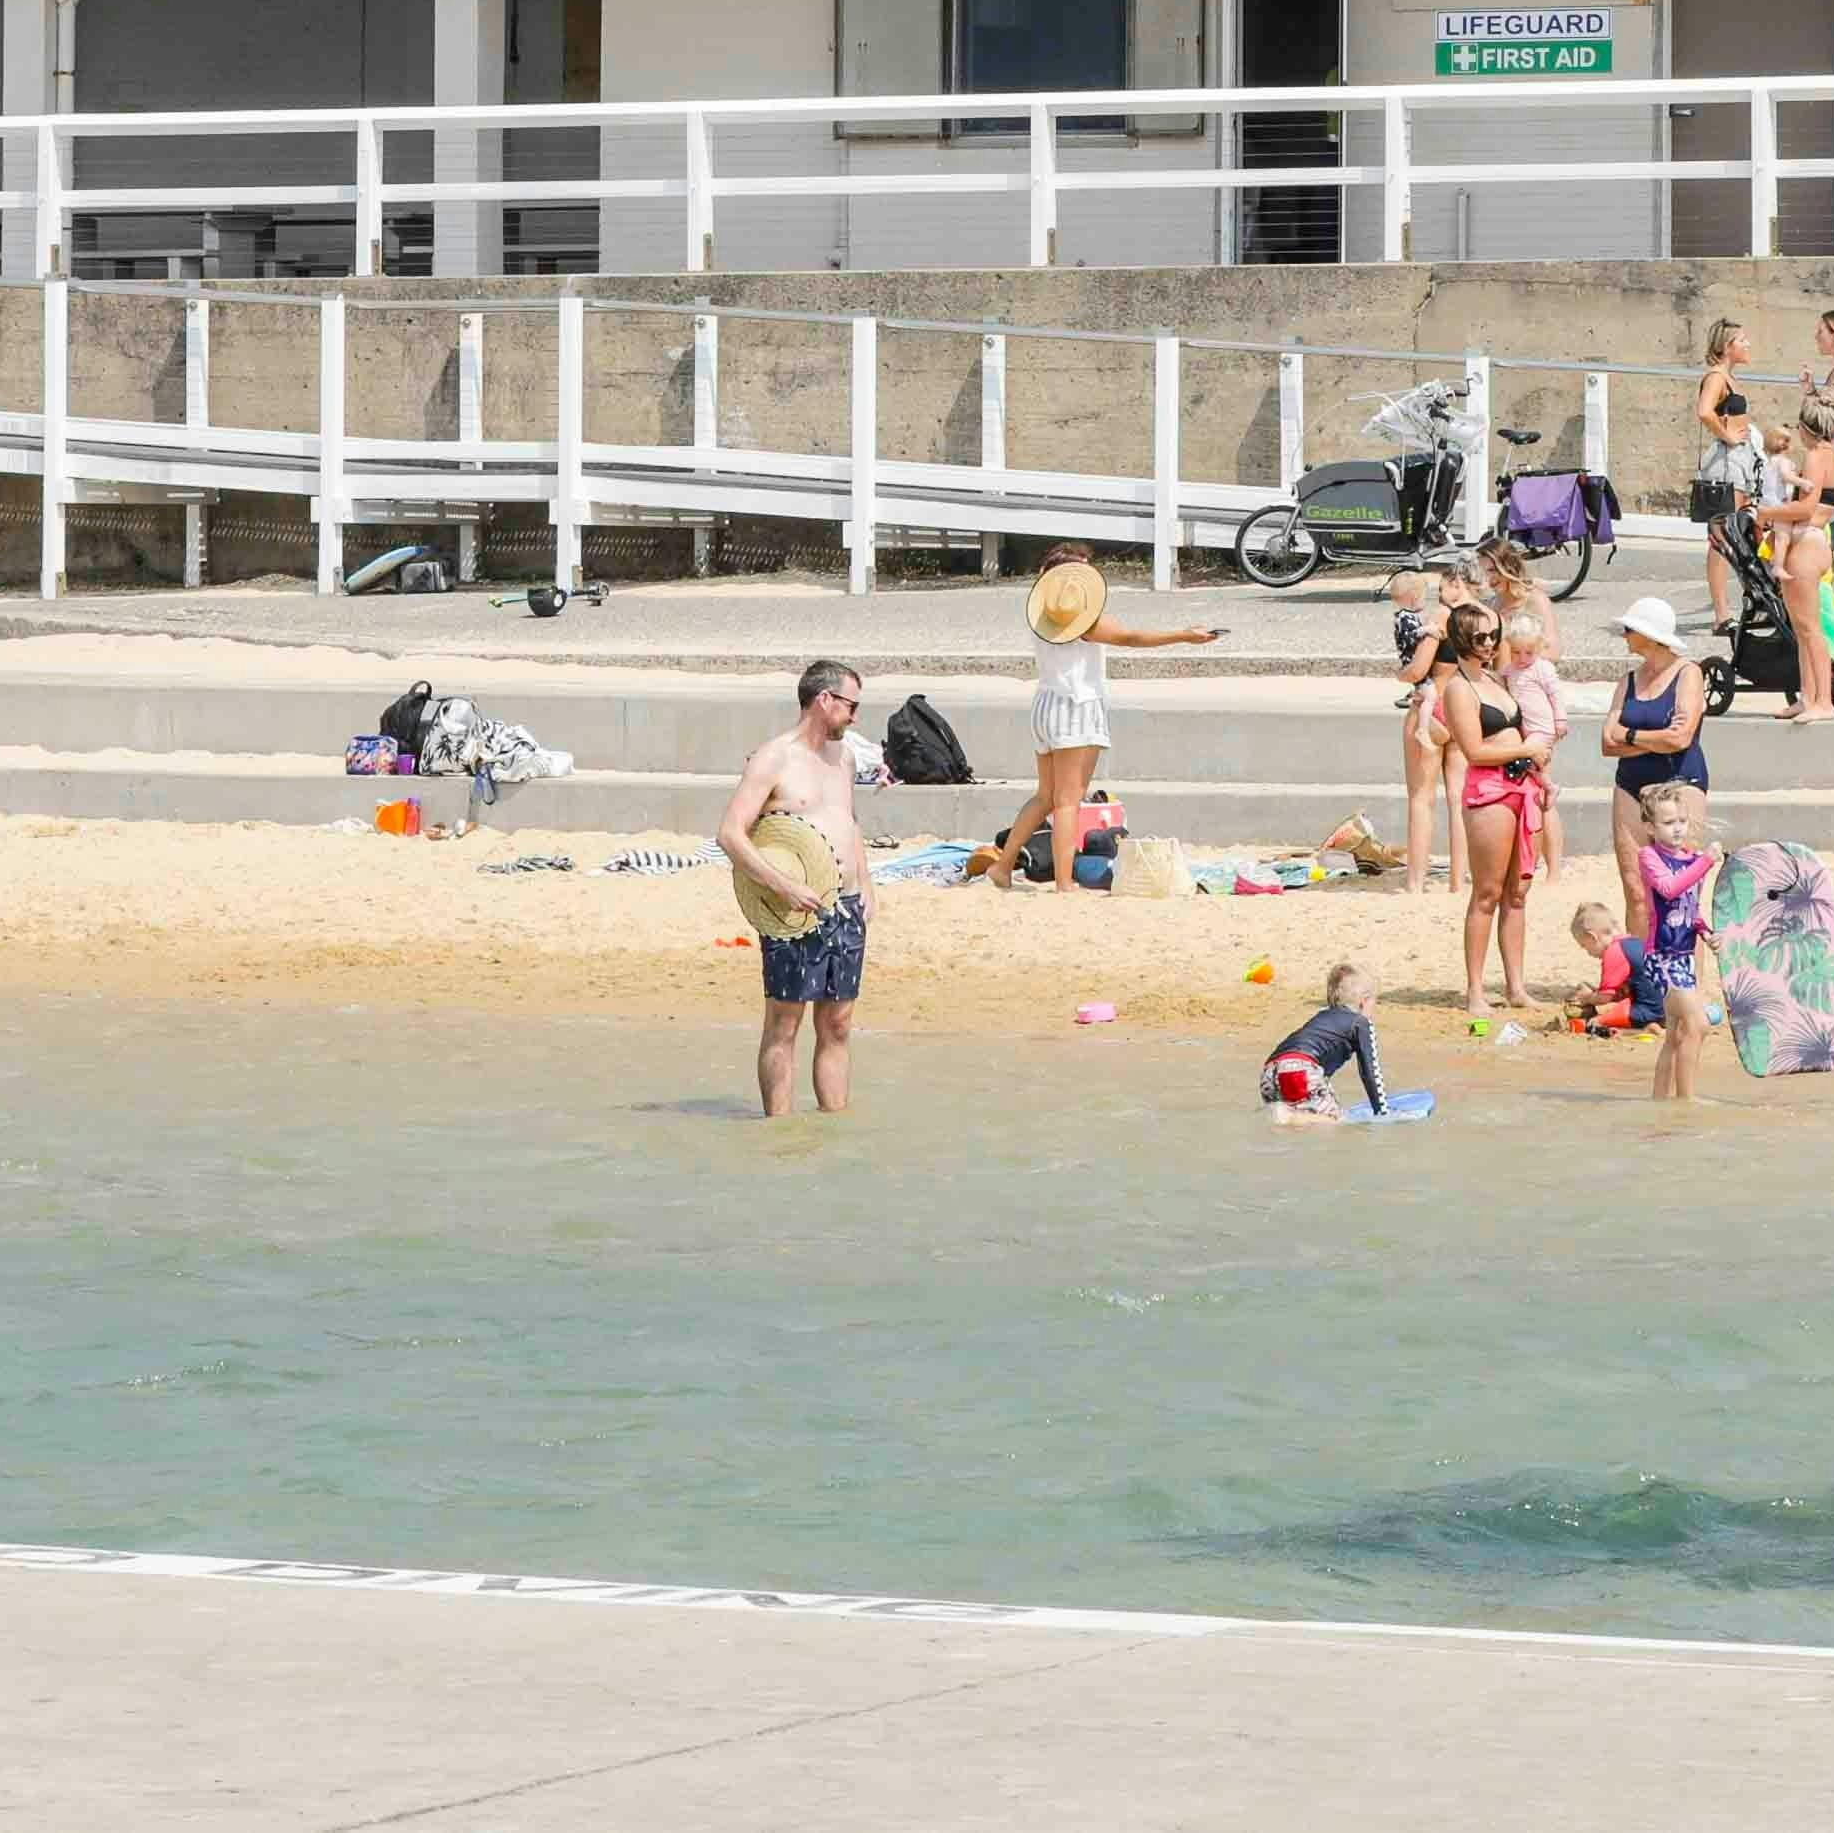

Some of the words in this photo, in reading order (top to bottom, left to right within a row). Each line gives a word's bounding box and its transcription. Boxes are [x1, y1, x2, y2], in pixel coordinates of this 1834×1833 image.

[1445, 13, 1604, 36] LIFEGUARD
[1481, 47, 1551, 70] FIRST
[1554, 46, 1597, 69] AID
[1306, 505, 1384, 519] Gazelle
[208, 1562, 1035, 1616] DIVING
